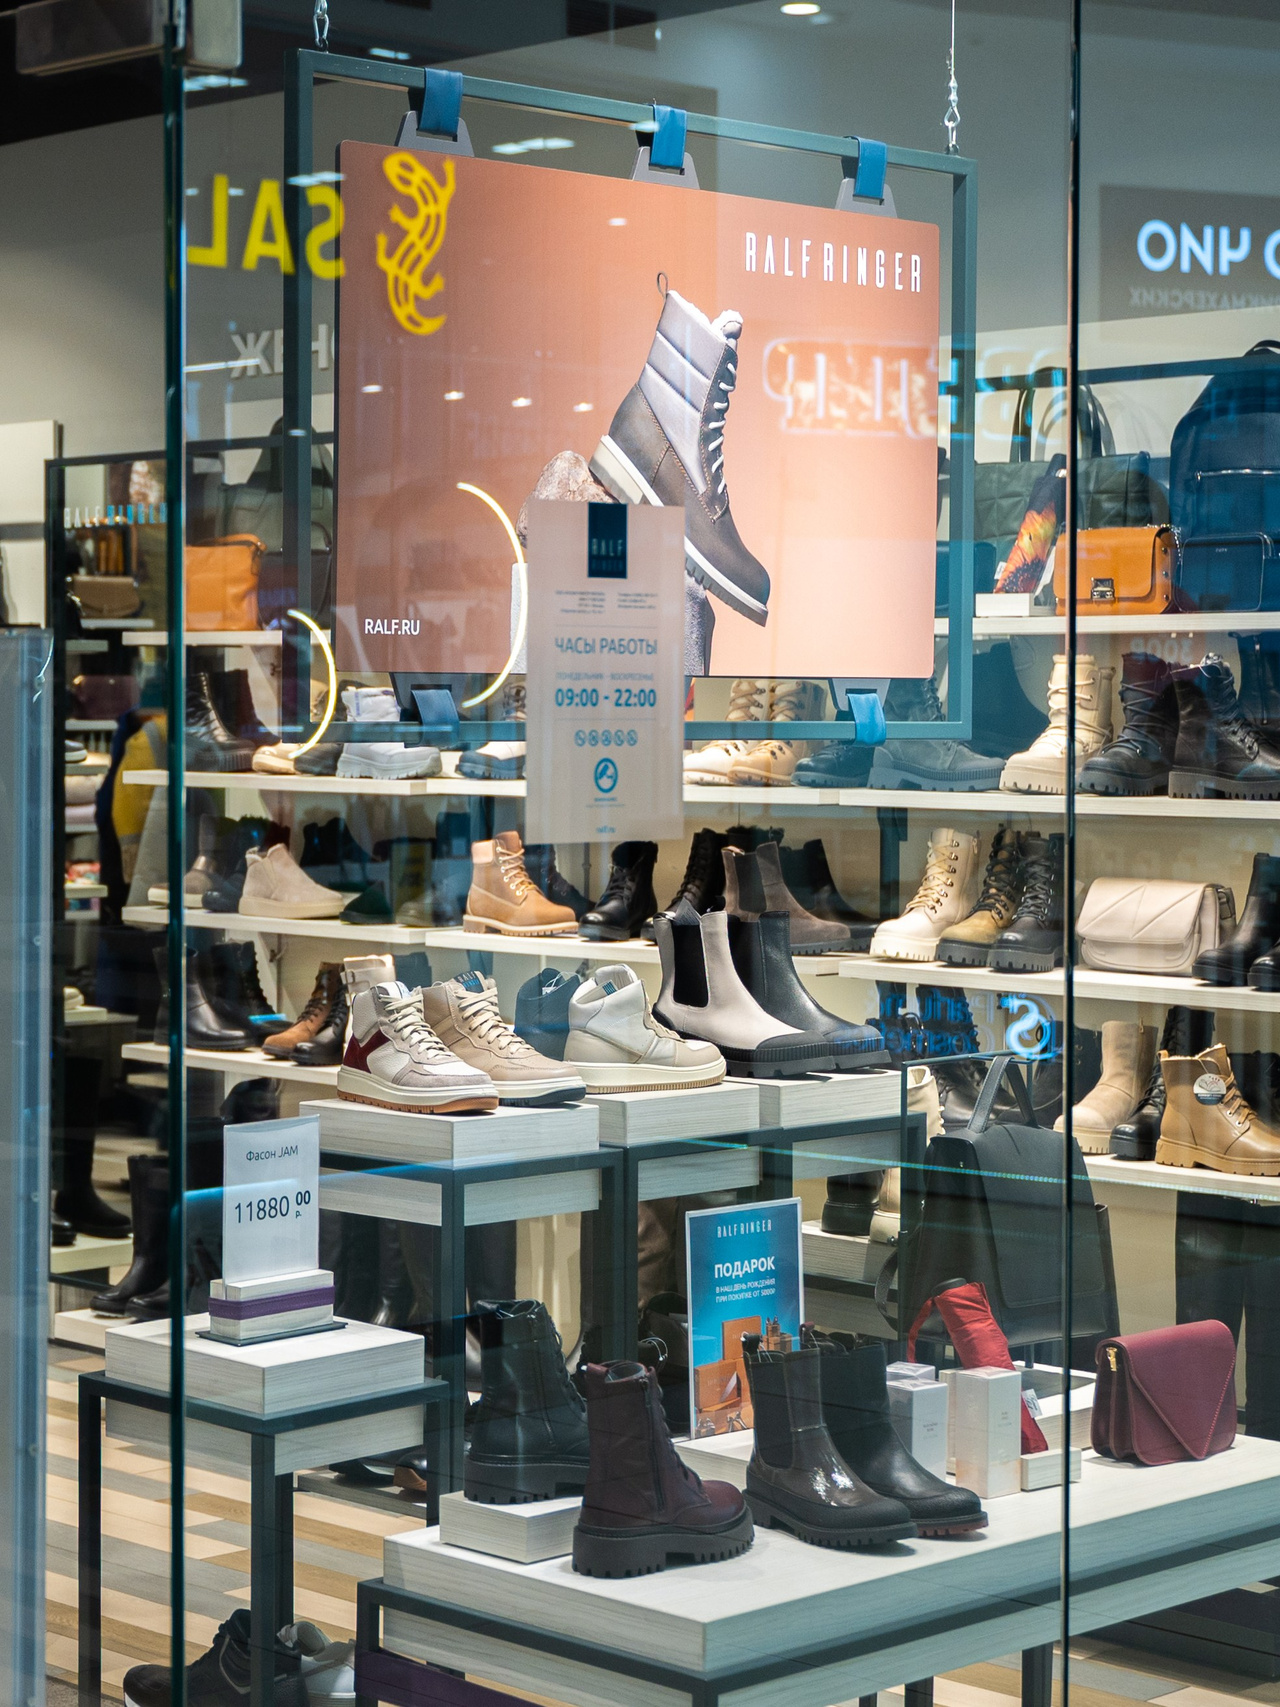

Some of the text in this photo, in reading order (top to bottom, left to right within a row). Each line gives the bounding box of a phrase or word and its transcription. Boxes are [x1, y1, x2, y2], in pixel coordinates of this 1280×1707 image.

[592, 538, 624, 556] RALF
[364, 618, 420, 636] RALF.RU
[554, 636, 658, 655] ЧАСЫ РАБОТЫ
[555, 688, 599, 707] 09:00
[614, 688, 657, 707] 22:00
[246, 1144, 299, 1162] Фасон JAM
[235, 1189, 311, 1224] 11880 00
[714, 1256, 776, 1279] ПОДАРОК
[733, 1282, 747, 1292] ДЕНЬ
[747, 1278, 776, 1289] РОЖДЕНИЯ
[715, 1295, 728, 1304] ПРИ
[728, 1291, 752, 1302] ПОКУПКЕ
[752, 1289, 761, 1298] ОТ
